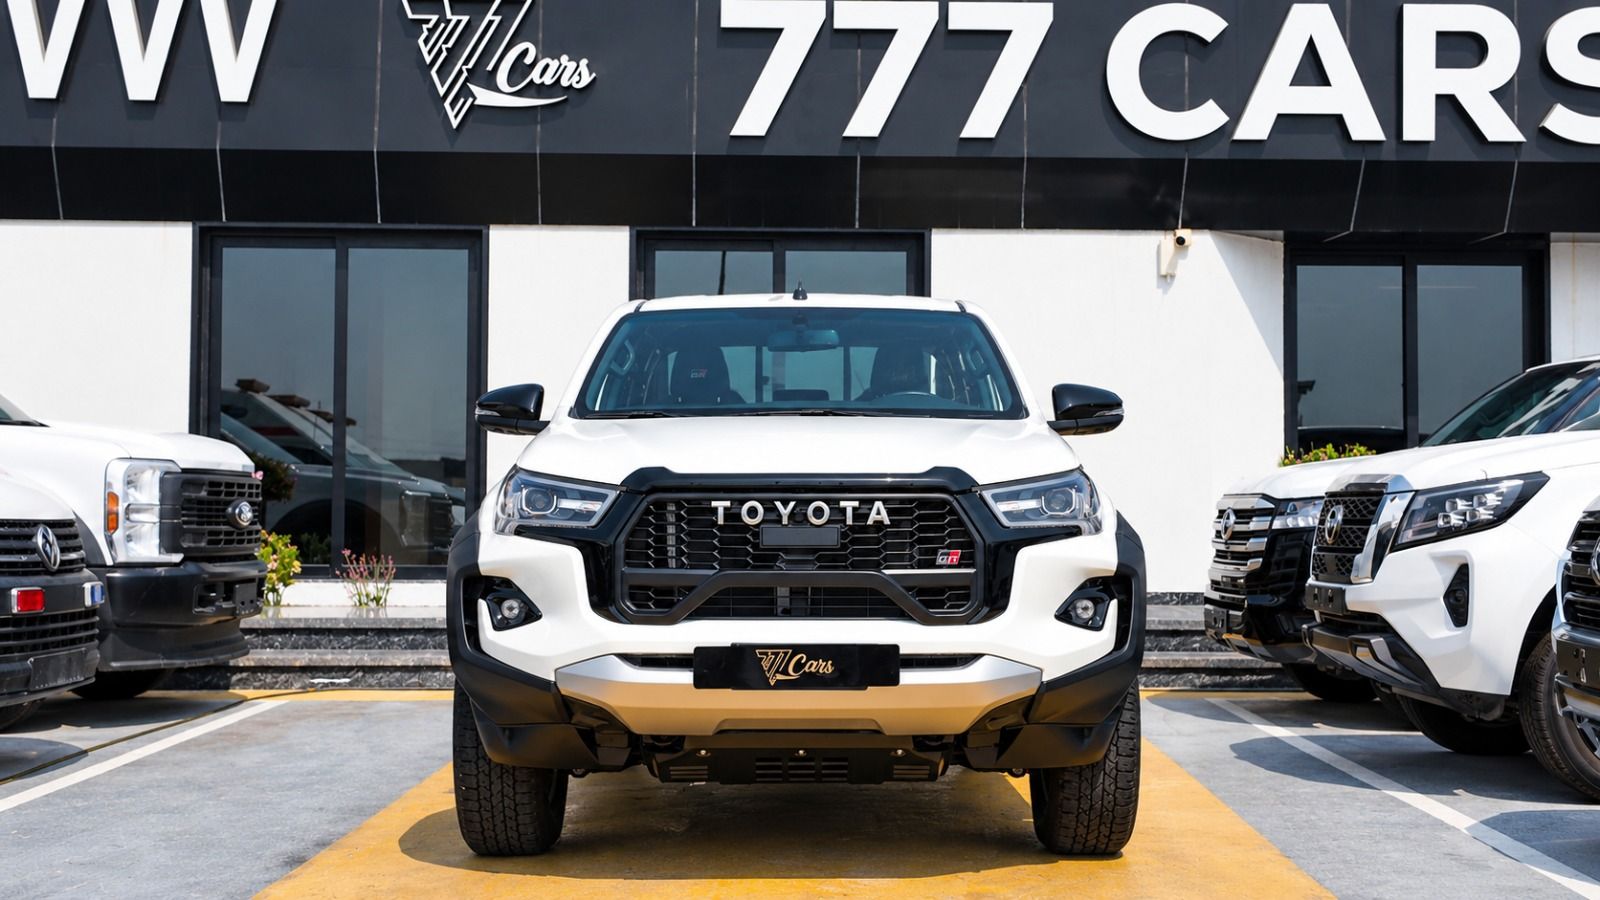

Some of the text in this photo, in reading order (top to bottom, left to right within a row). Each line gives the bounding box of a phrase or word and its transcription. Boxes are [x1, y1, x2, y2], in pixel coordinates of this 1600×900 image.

[496, 41, 597, 93] Cars
[720, 0, 1054, 139] 777
[711, 500, 891, 526] TOYOTA
[788, 653, 835, 676] Cars
